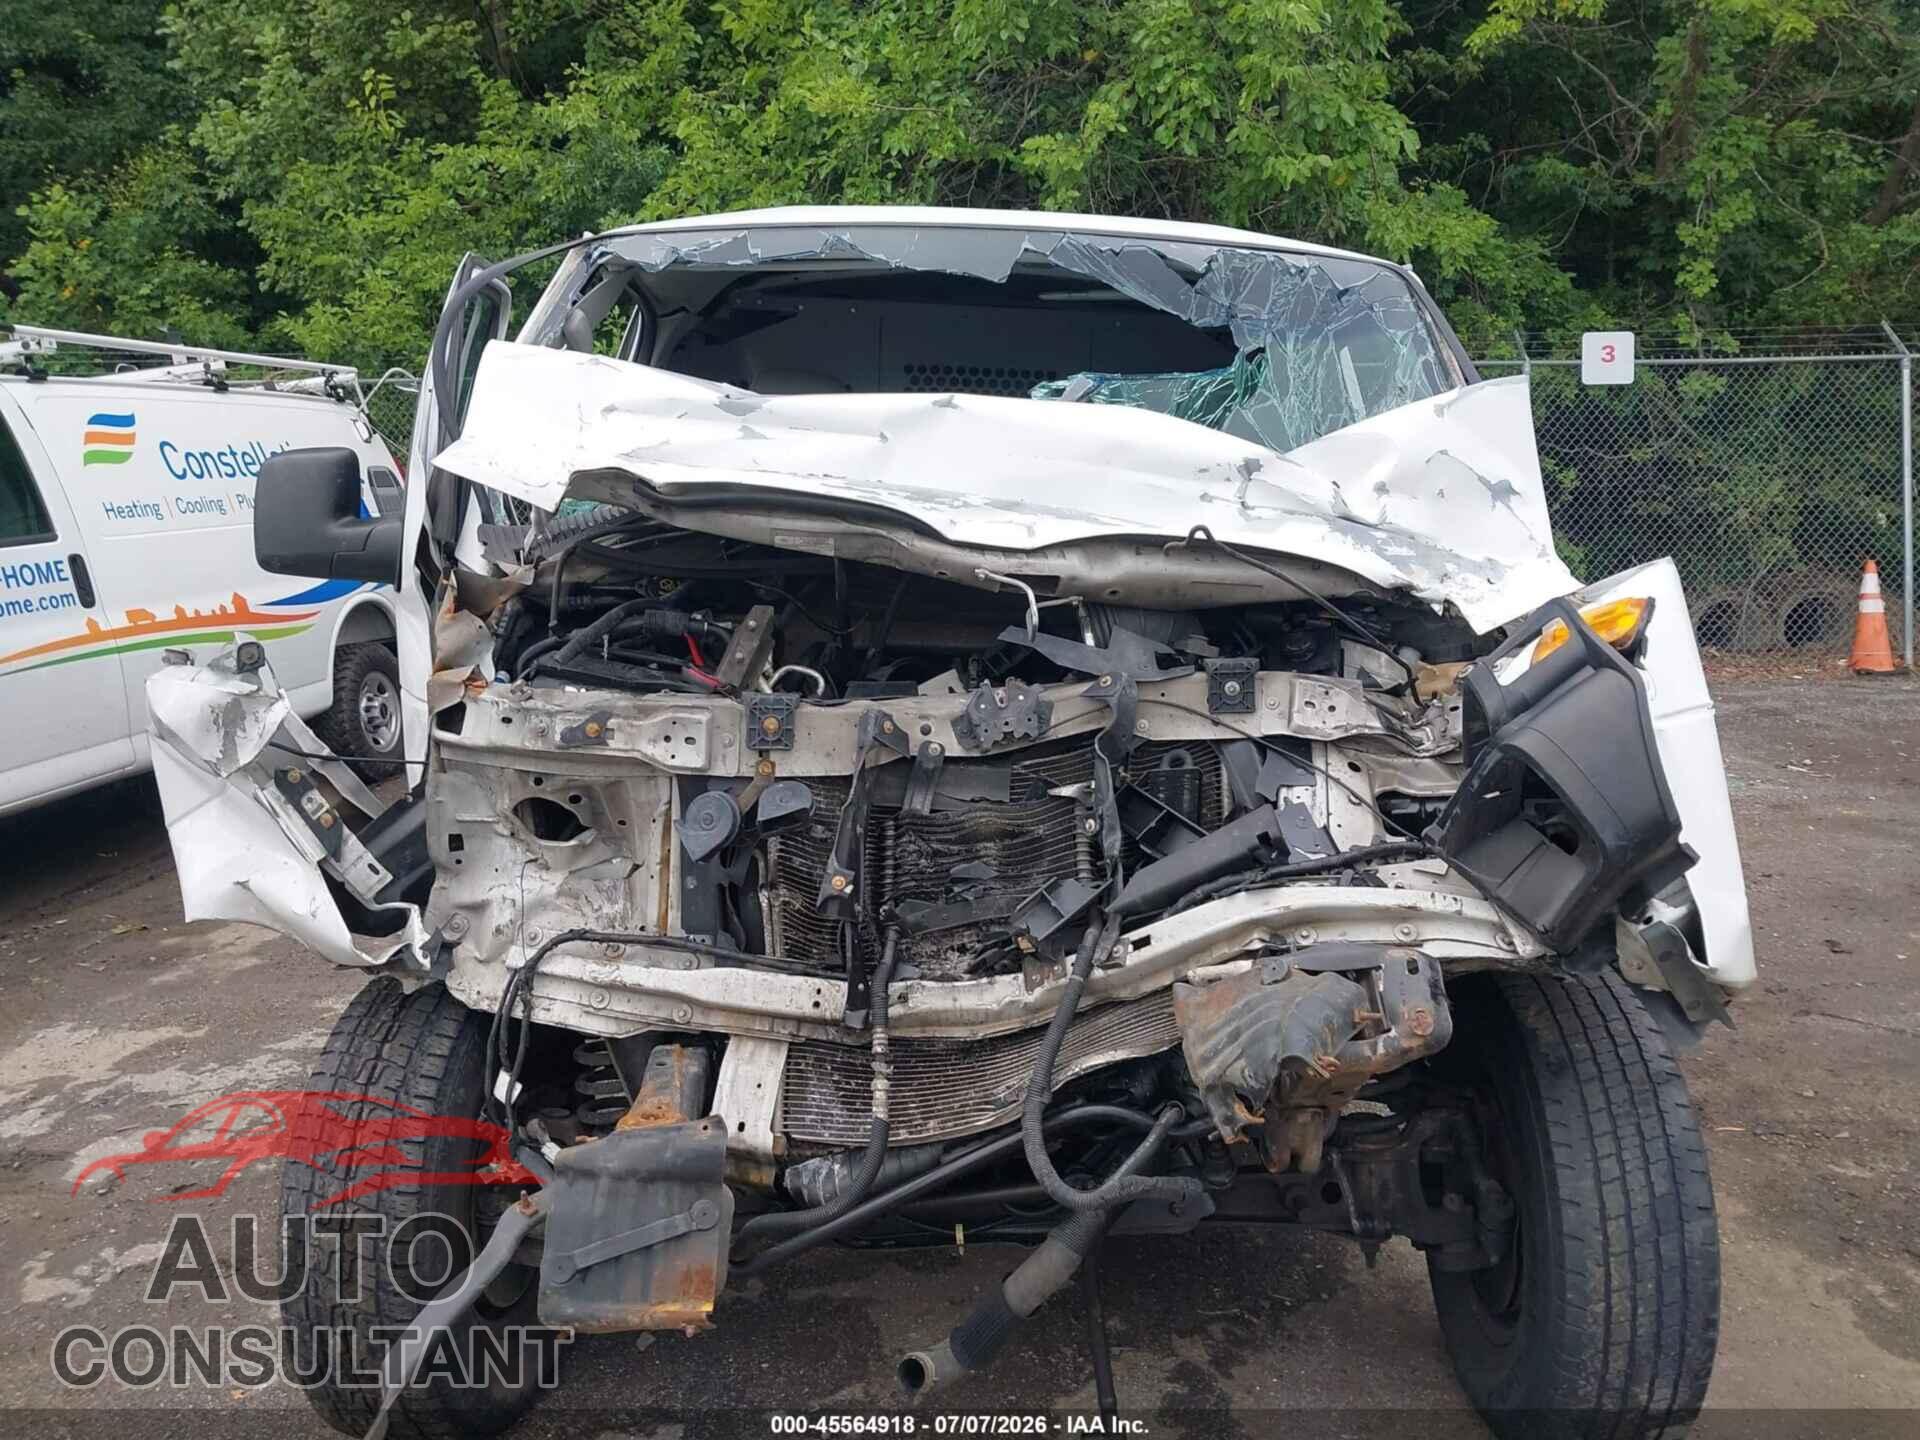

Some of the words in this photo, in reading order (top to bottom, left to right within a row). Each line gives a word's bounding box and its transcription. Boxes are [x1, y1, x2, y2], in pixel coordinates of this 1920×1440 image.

[1601, 345, 1616, 363] 3
[159, 441, 289, 480] Constell
[102, 500, 164, 521] Heating
[175, 496, 227, 516] Cooling
